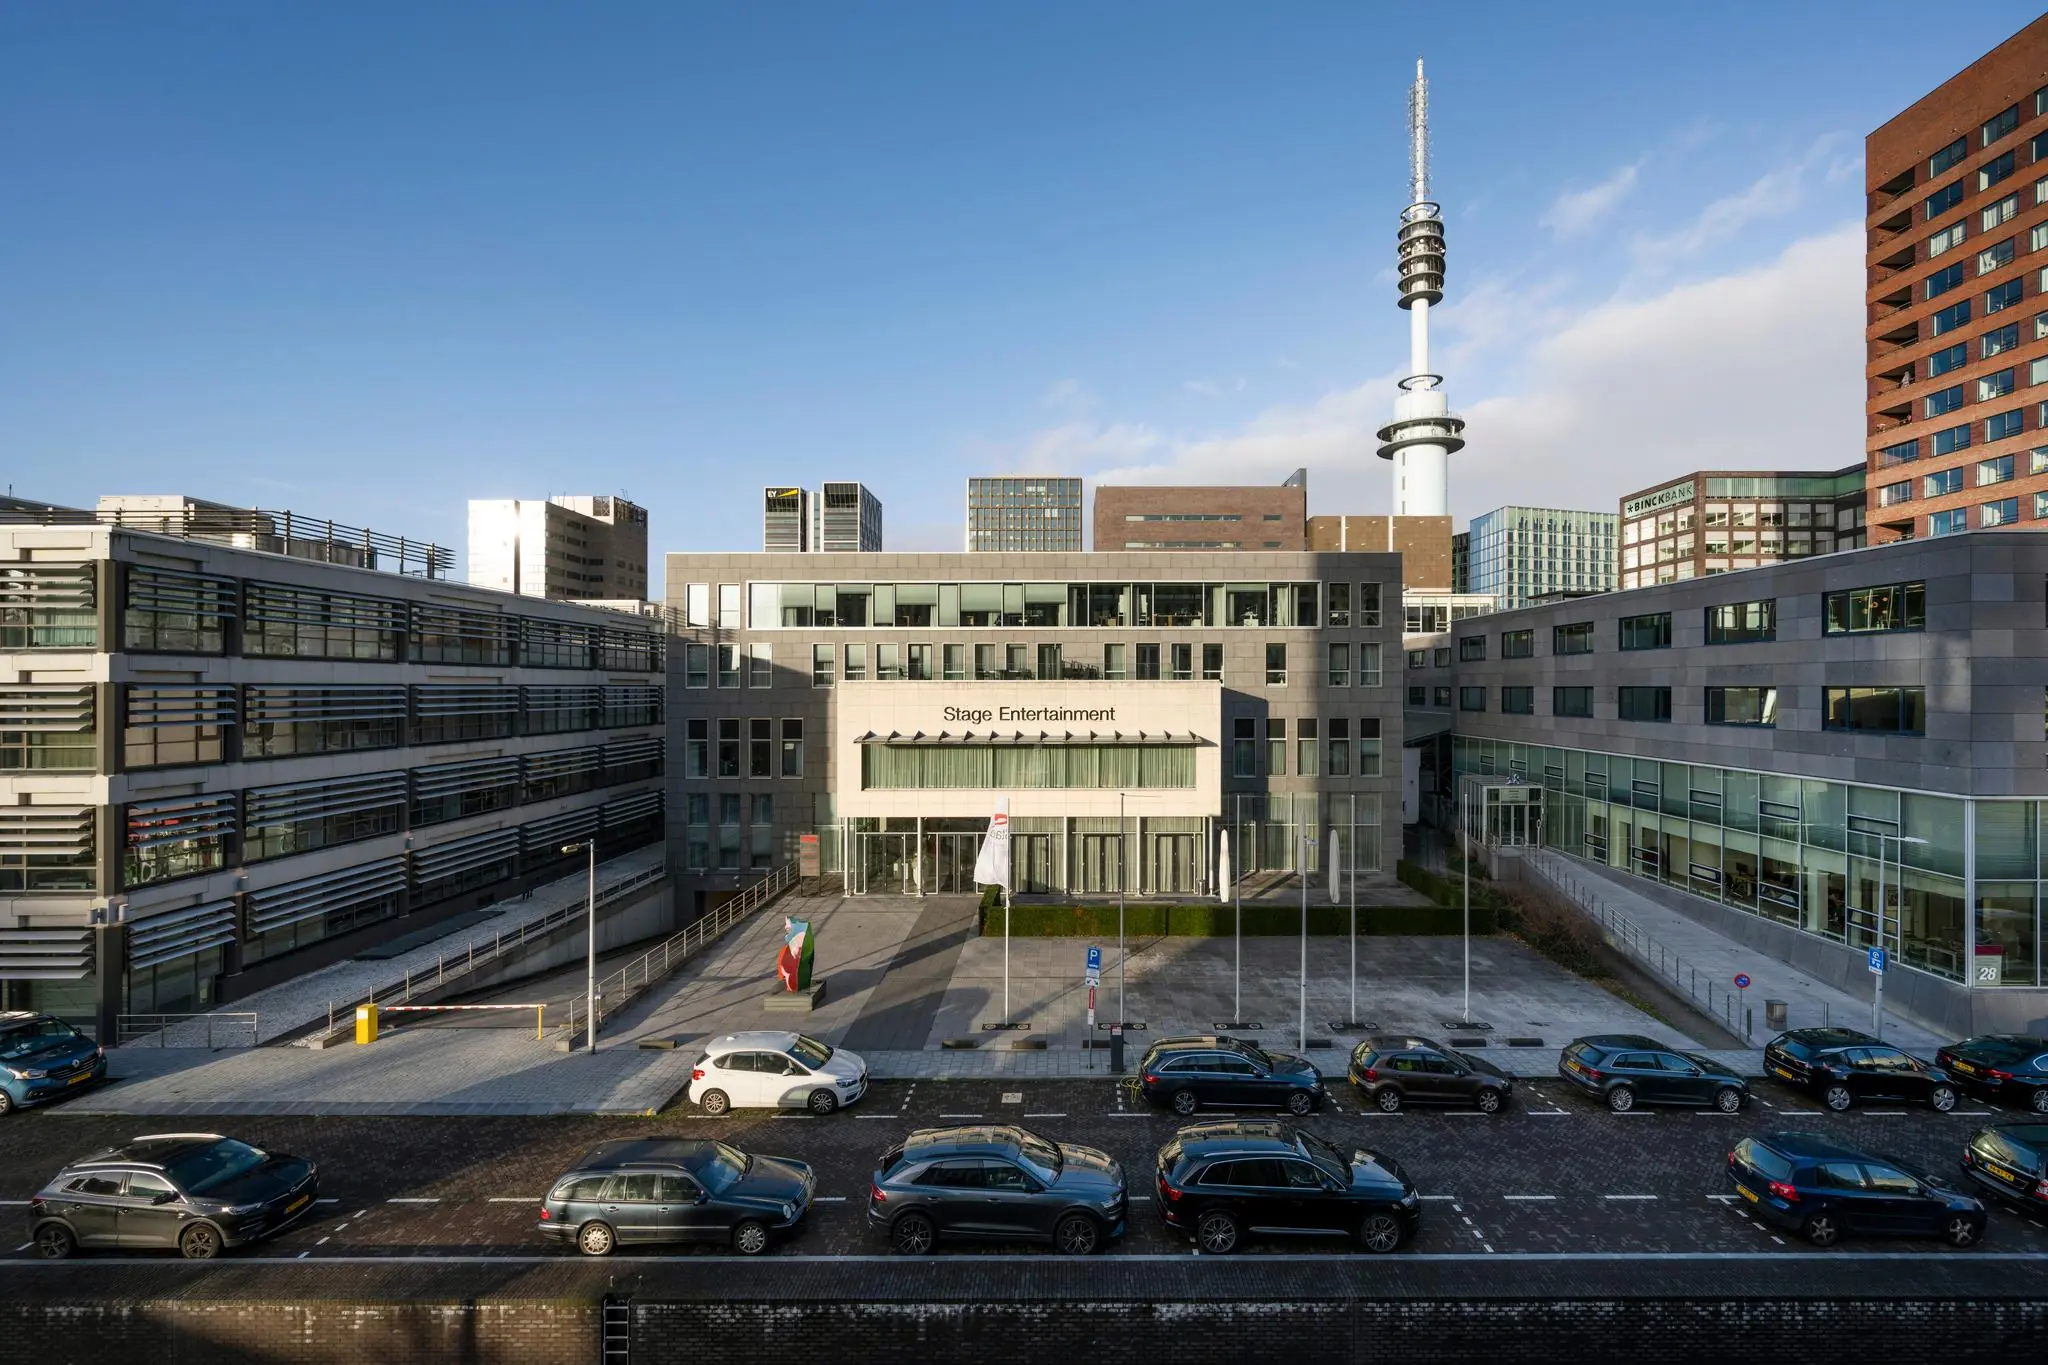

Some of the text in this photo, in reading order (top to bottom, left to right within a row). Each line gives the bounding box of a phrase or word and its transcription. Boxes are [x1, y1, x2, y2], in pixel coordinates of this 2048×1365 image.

[767, 490, 777, 498] EY
[1634, 484, 1693, 511] BINCKBANK
[943, 706, 1116, 725] Stage Entertainment
[1090, 949, 1098, 961] P
[1979, 967, 1997, 981] 28
